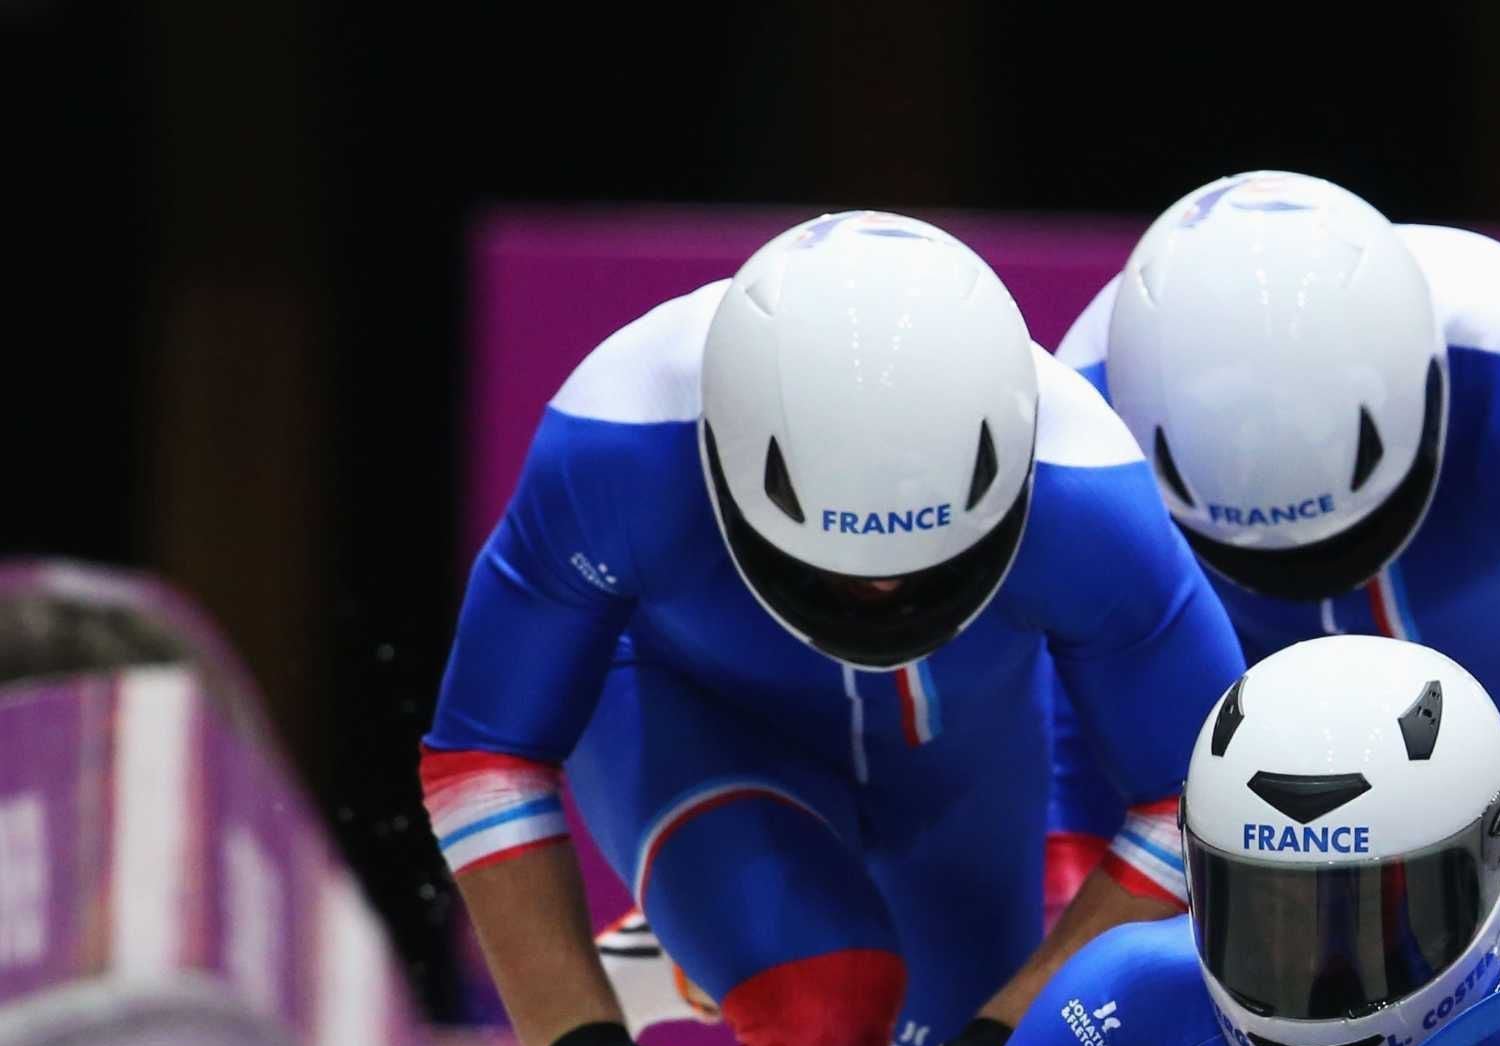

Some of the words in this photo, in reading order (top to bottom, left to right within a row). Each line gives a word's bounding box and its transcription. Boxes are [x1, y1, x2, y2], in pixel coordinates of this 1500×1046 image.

[822, 503, 951, 534] FRANCE
[1208, 494, 1334, 526] FRANCE
[1243, 824, 1369, 853] FRANCE
